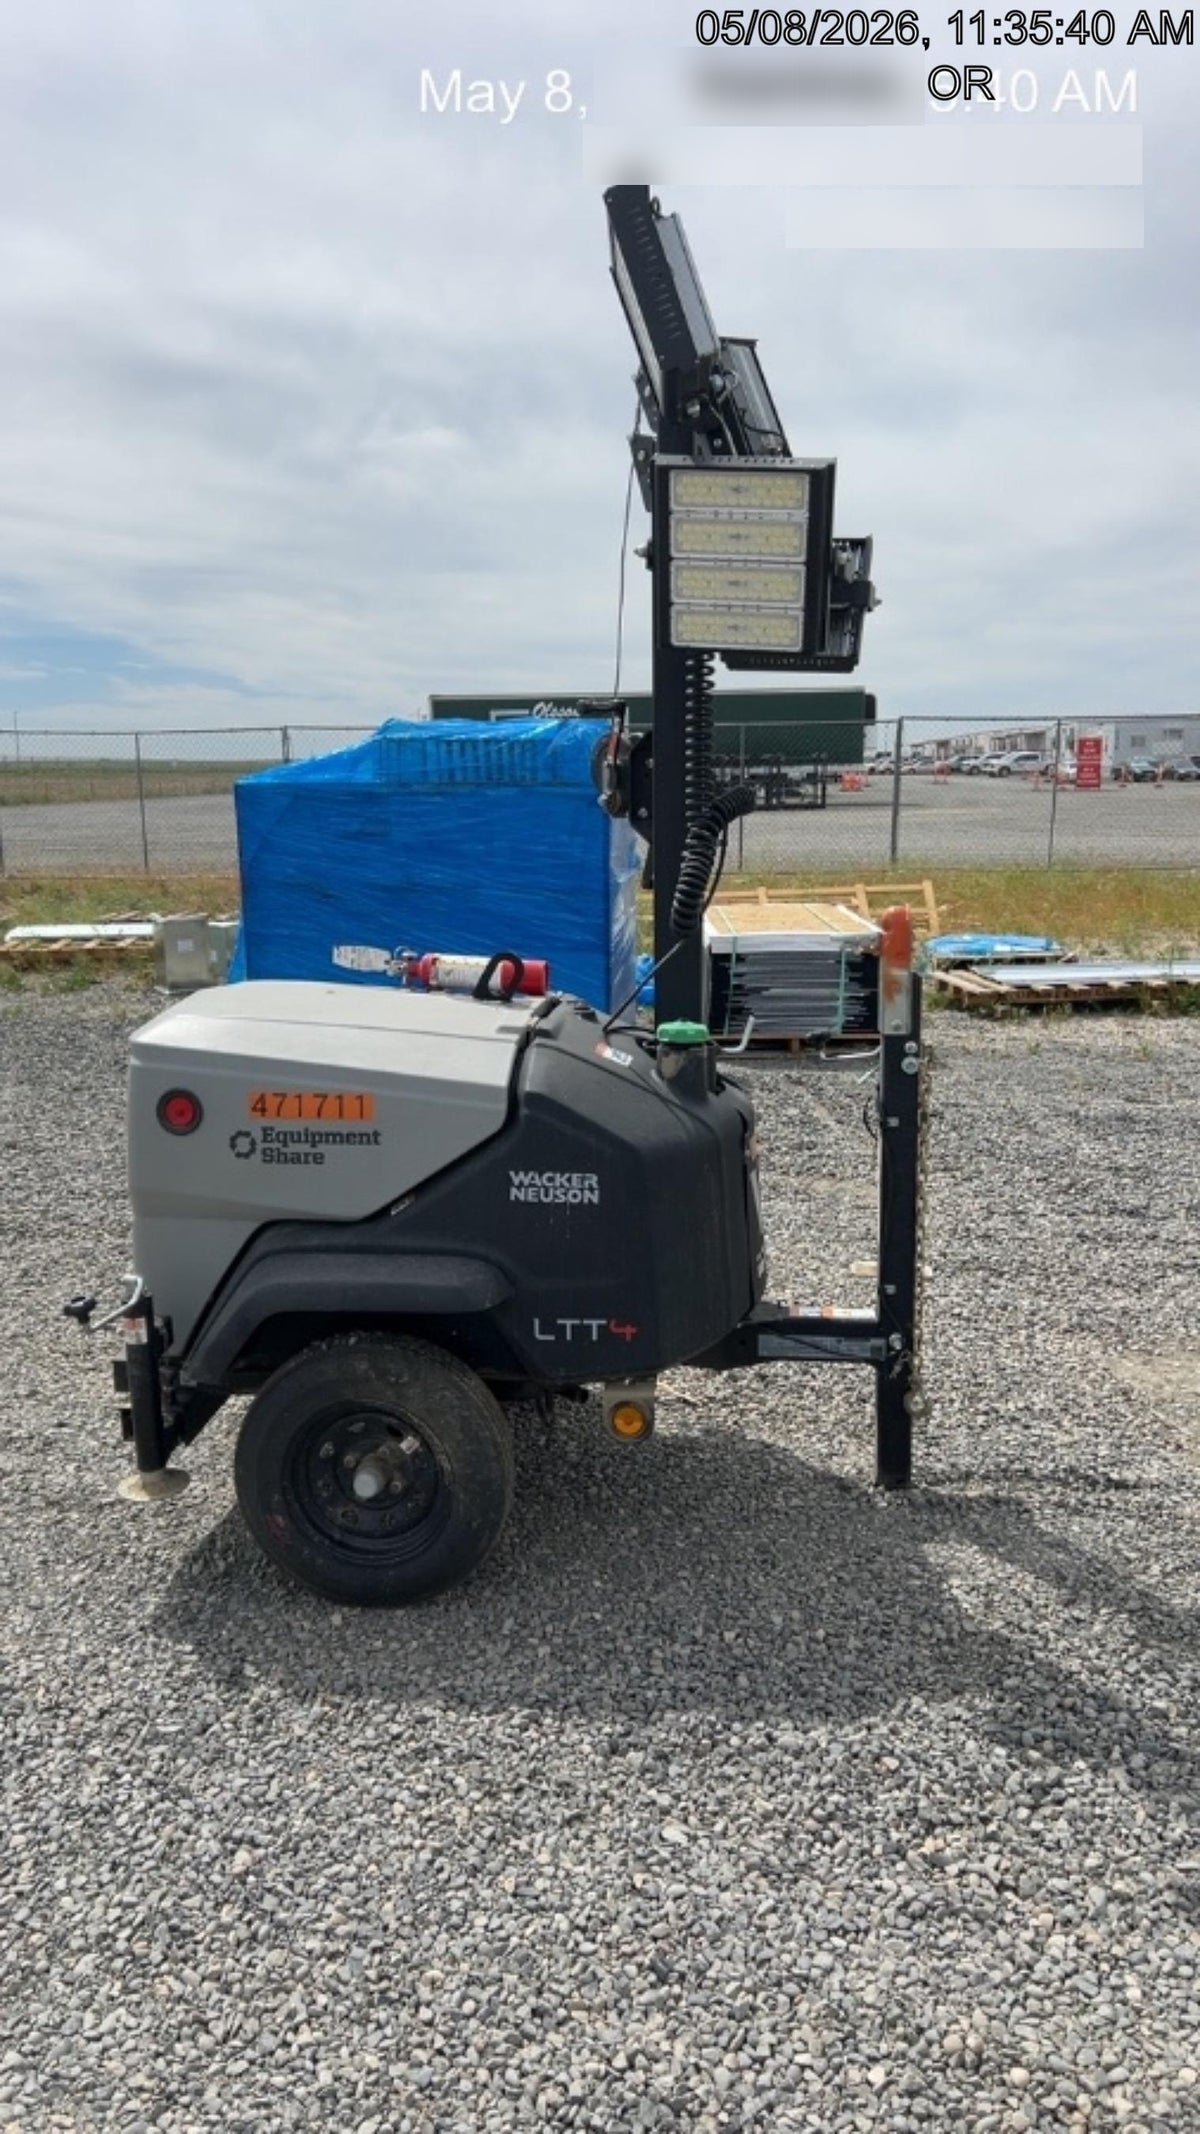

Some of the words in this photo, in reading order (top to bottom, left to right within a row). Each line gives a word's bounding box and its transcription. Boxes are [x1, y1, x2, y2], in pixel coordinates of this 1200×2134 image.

[250, 1093, 368, 1120] 471711
[260, 1126, 382, 1148] Equipment
[260, 1147, 326, 1166] Share
[508, 1170, 600, 1190] WACKER
[508, 1187, 600, 1205] NEUSON
[533, 1317, 638, 1342] LTT4
